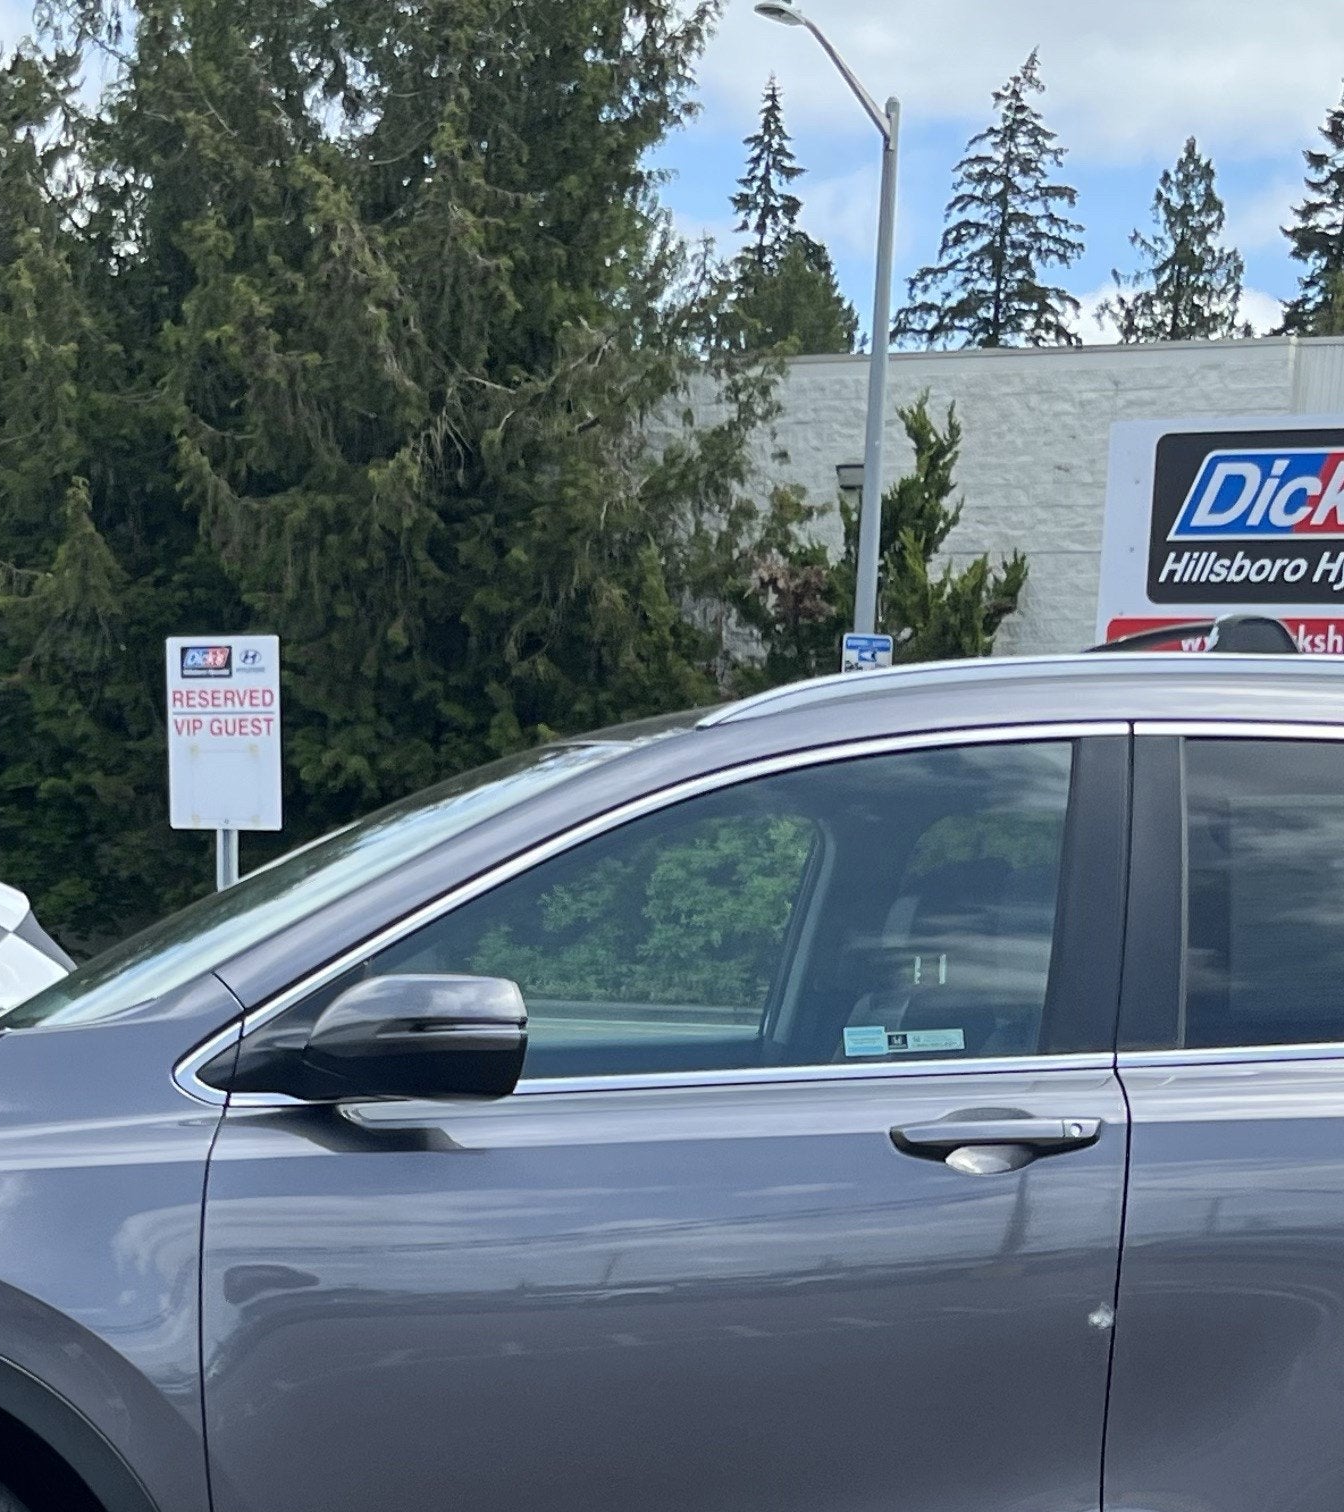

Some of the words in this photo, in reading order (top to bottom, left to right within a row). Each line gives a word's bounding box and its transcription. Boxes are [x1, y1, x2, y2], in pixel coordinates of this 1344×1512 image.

[1158, 551, 1308, 583] Hillsboro
[172, 688, 274, 708] RESERVED
[174, 718, 203, 736] VIP
[210, 718, 274, 736] GUEST
